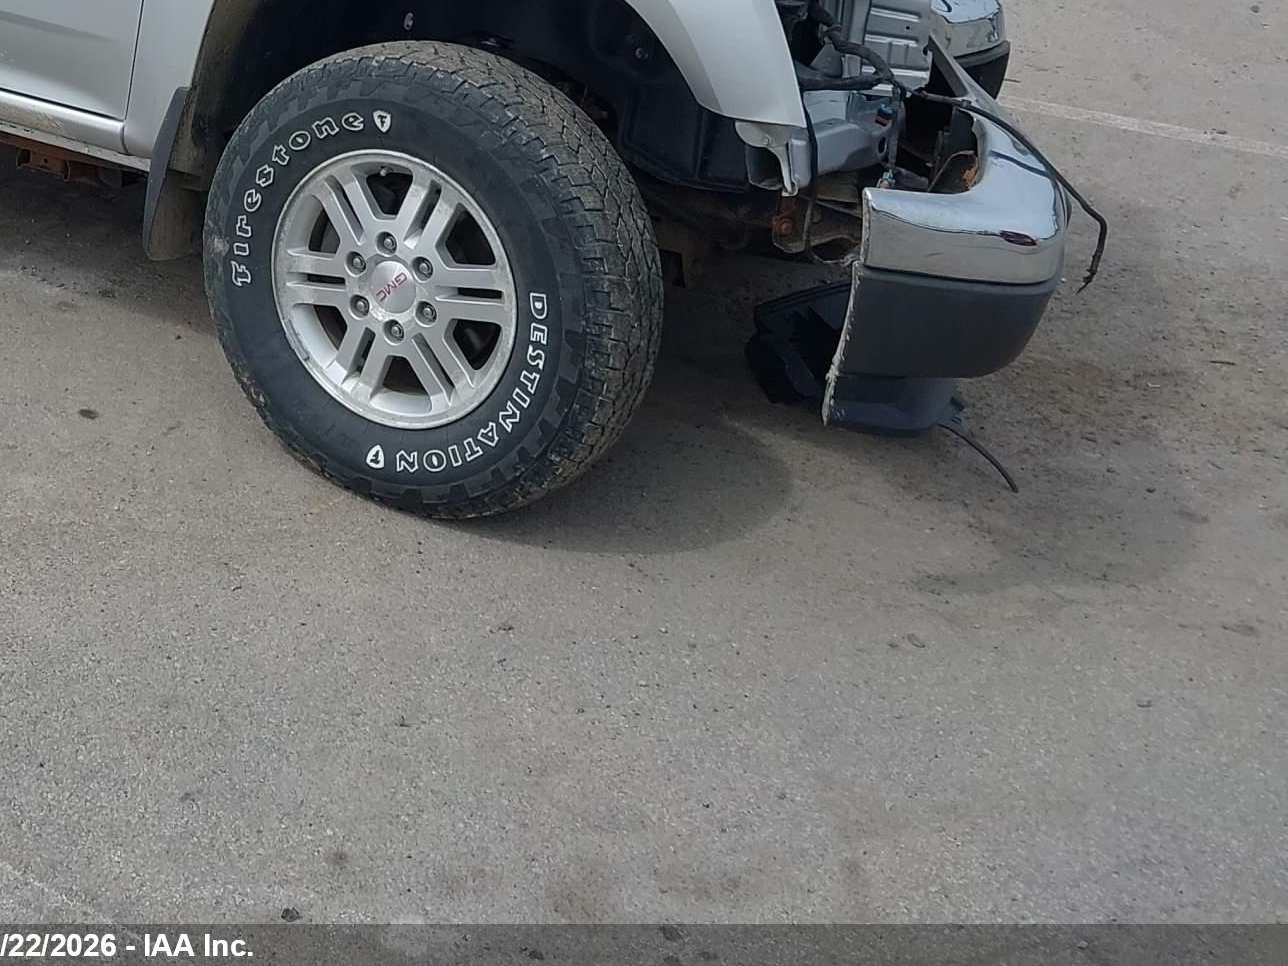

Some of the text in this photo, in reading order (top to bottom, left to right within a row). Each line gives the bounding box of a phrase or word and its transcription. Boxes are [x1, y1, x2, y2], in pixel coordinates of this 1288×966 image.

[232, 110, 365, 288] Firestone
[375, 272, 408, 303] GMC
[395, 291, 549, 473] DESTINATION
